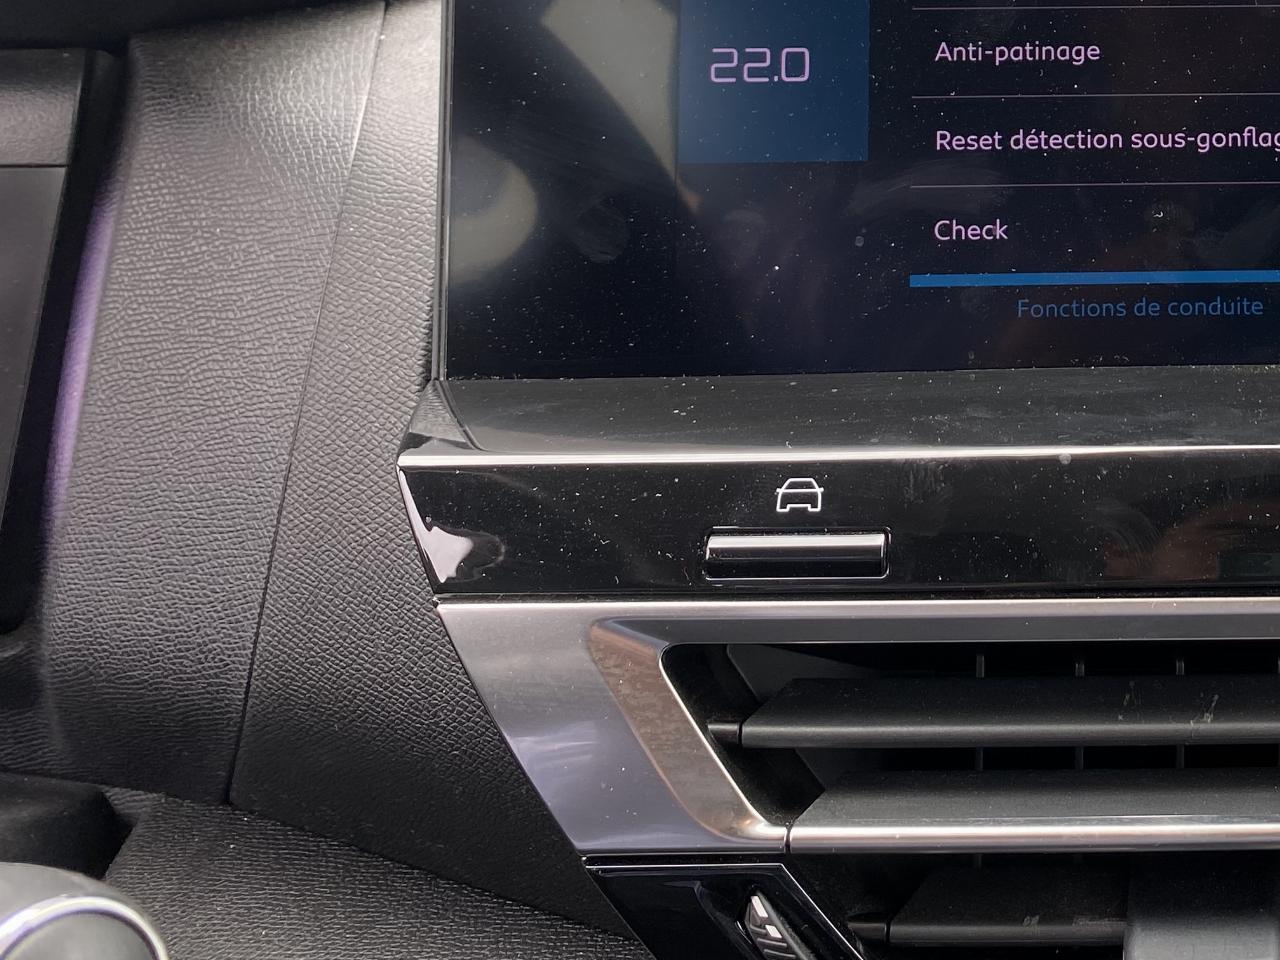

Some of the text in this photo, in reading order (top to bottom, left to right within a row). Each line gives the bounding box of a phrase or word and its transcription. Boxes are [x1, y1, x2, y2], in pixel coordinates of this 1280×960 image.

[710, 47, 810, 83] 22.0
[935, 41, 1100, 66] Anti-patinage
[936, 130, 1003, 151] Reset
[1010, 128, 1123, 150] détection
[934, 218, 1008, 241] Check
[1017, 295, 1264, 318] Fonctions de conduite
